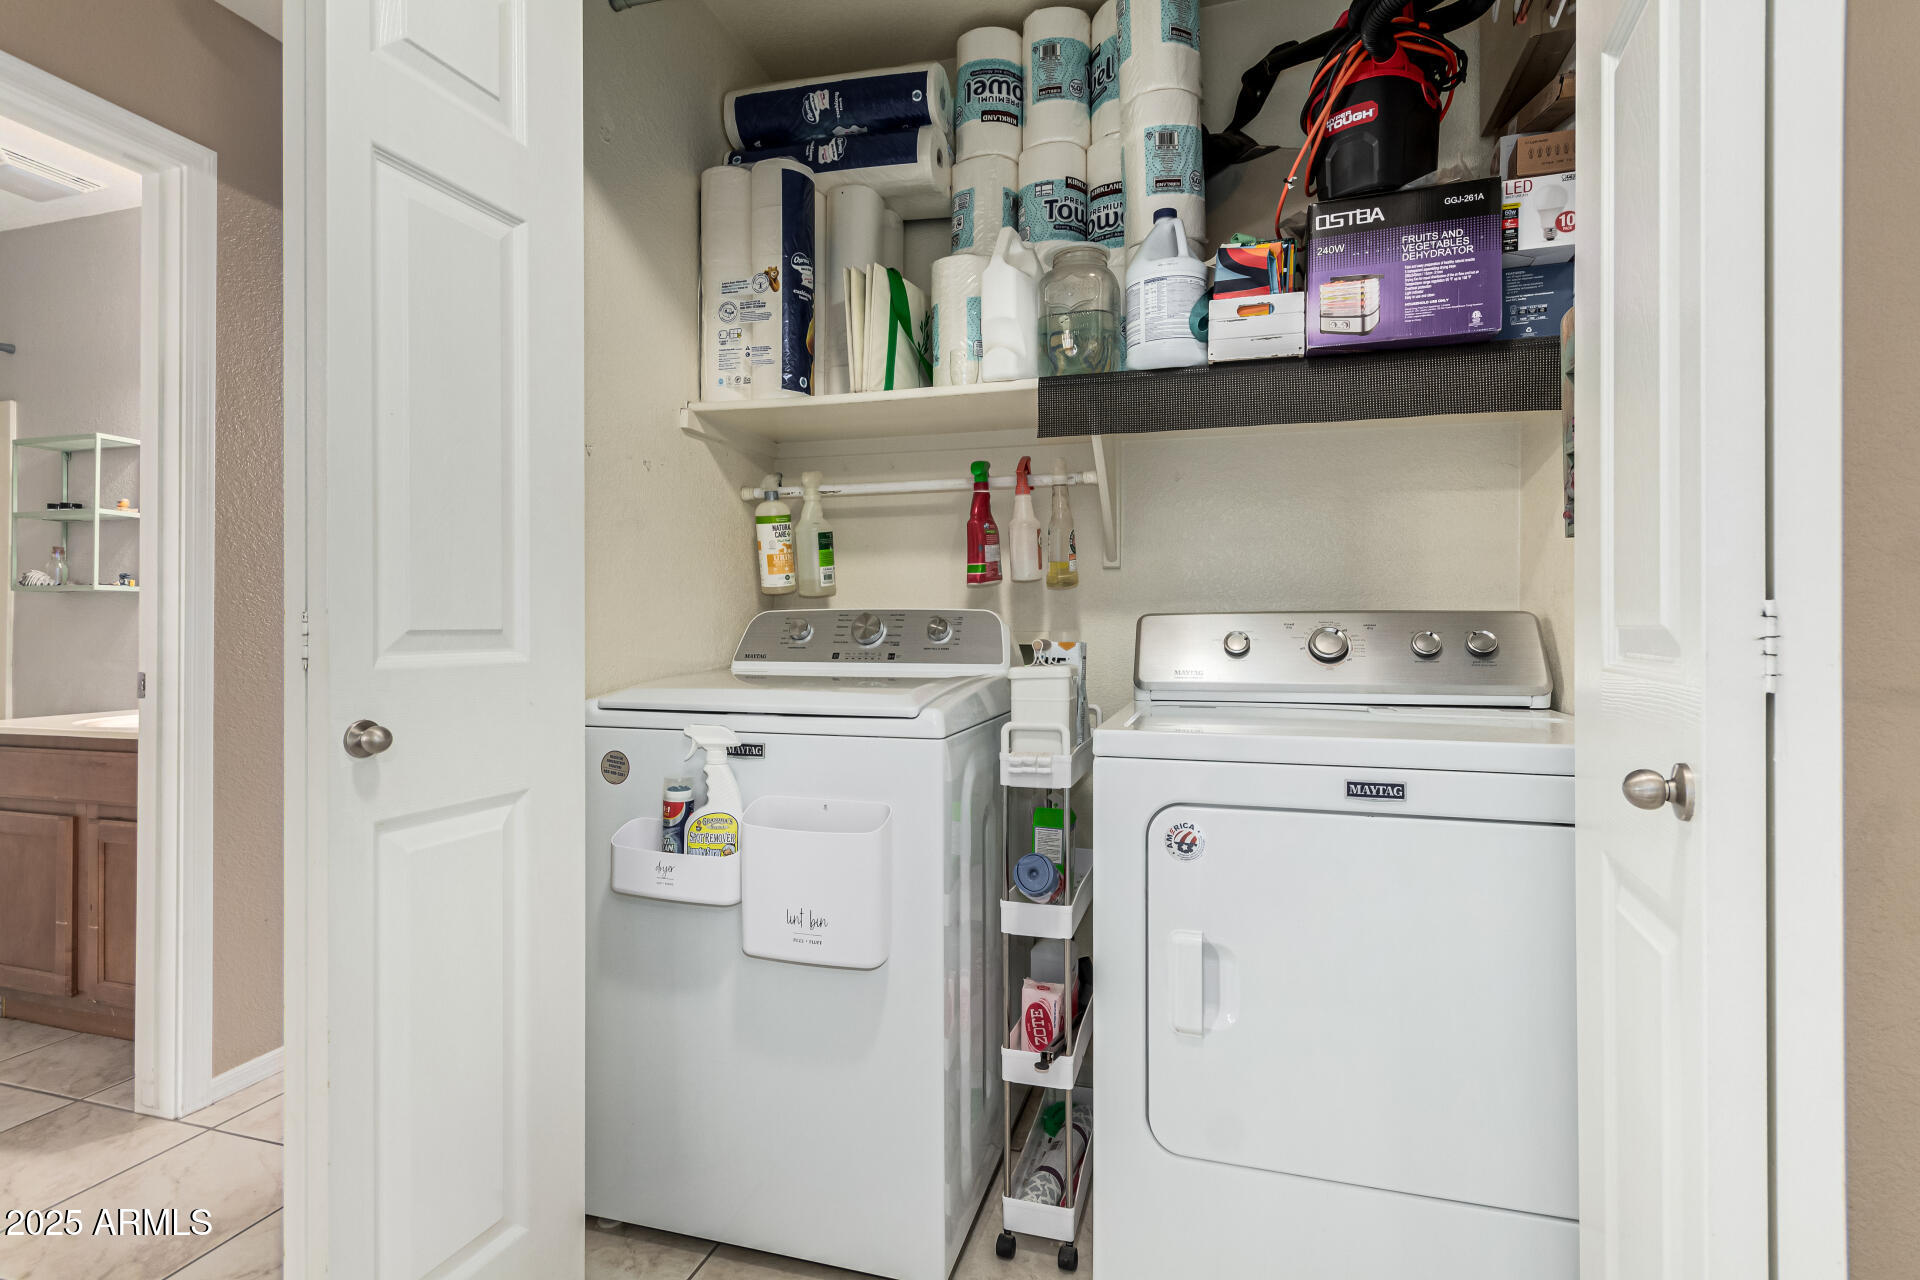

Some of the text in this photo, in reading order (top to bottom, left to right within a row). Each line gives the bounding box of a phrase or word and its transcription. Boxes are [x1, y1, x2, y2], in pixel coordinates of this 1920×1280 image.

[982, 114, 1017, 125] KIRKLAND
[1327, 110, 1351, 125] HYPER
[1327, 108, 1373, 132] TOUGH
[1091, 182, 1122, 196] KIRKLAND
[1505, 180, 1533, 195] LED
[1444, 193, 1485, 205] GGJ-261A
[1315, 207, 1385, 231] OSTBA
[1559, 213, 1575, 227] 10
[1402, 229, 1464, 244] FRUITS AND
[1317, 244, 1345, 256] 240W
[1402, 237, 1470, 252] VEGETABLES
[1402, 245, 1474, 261] DEHYDRATOR
[727, 745, 763, 755] MAYTAG
[1349, 784, 1403, 797] MAYTAG
[1166, 822, 1195, 849] AMERICA
[810, 909, 829, 930] bin
[1030, 1008, 1048, 1046] ZOTE
